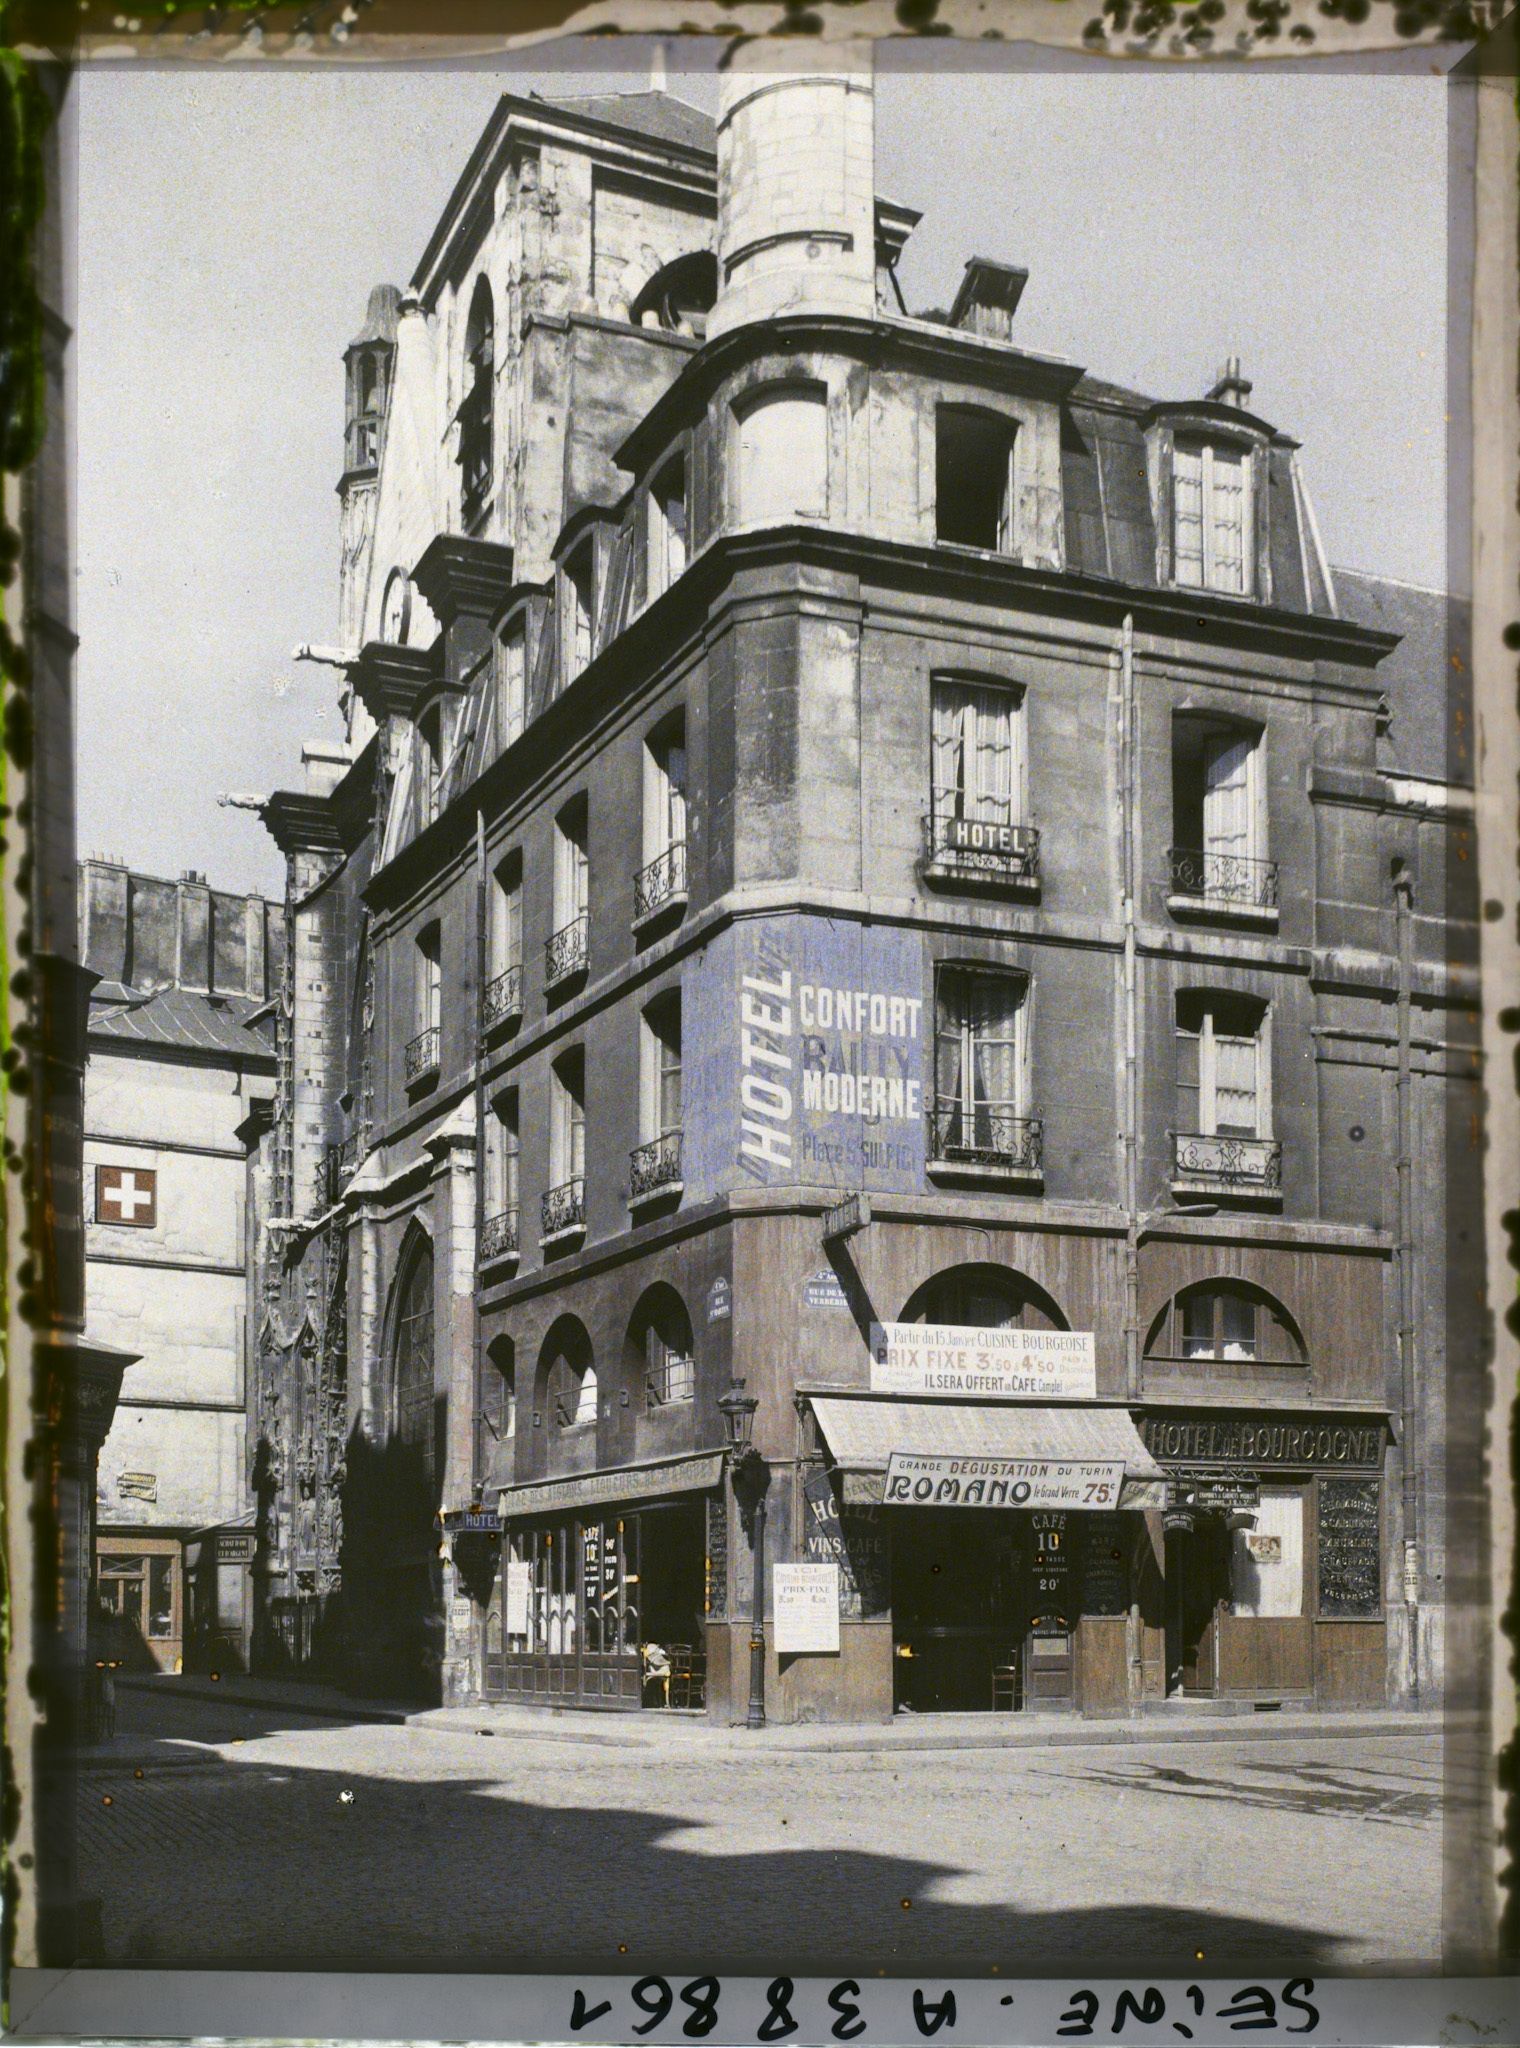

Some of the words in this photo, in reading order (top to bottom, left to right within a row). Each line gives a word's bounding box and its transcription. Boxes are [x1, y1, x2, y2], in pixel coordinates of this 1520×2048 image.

[957, 822, 1025, 853] HOTEL
[800, 985, 922, 1038] CONFORT
[741, 970, 793, 1168] HOTEL
[803, 1069, 921, 1119] MODERNE
[809, 1288, 824, 1296] RUE
[894, 1328, 919, 1345] Partir
[922, 1330, 935, 1345] du
[935, 1331, 946, 1345] 15
[977, 1332, 1019, 1349] CUISINE
[1022, 1332, 1089, 1352] BOURGEOISE
[877, 1347, 919, 1370] PRIX
[927, 1350, 967, 1370] FIXE
[925, 1374, 936, 1388] IL
[937, 1375, 963, 1389] SERA
[966, 1375, 1005, 1392] OFFERT
[1151, 1422, 1220, 1457] HOTEL
[1240, 1426, 1381, 1461] BOURGOGNE
[899, 1461, 942, 1472] GRANDE
[1057, 1467, 1072, 1476] DU
[1080, 1467, 1113, 1476] TURIN
[887, 1475, 1032, 1506] ROMANO
[1040, 1486, 1060, 1499] Grand
[1061, 1486, 1080, 1499] Verre
[1032, 1513, 1067, 1531] CAFÉ
